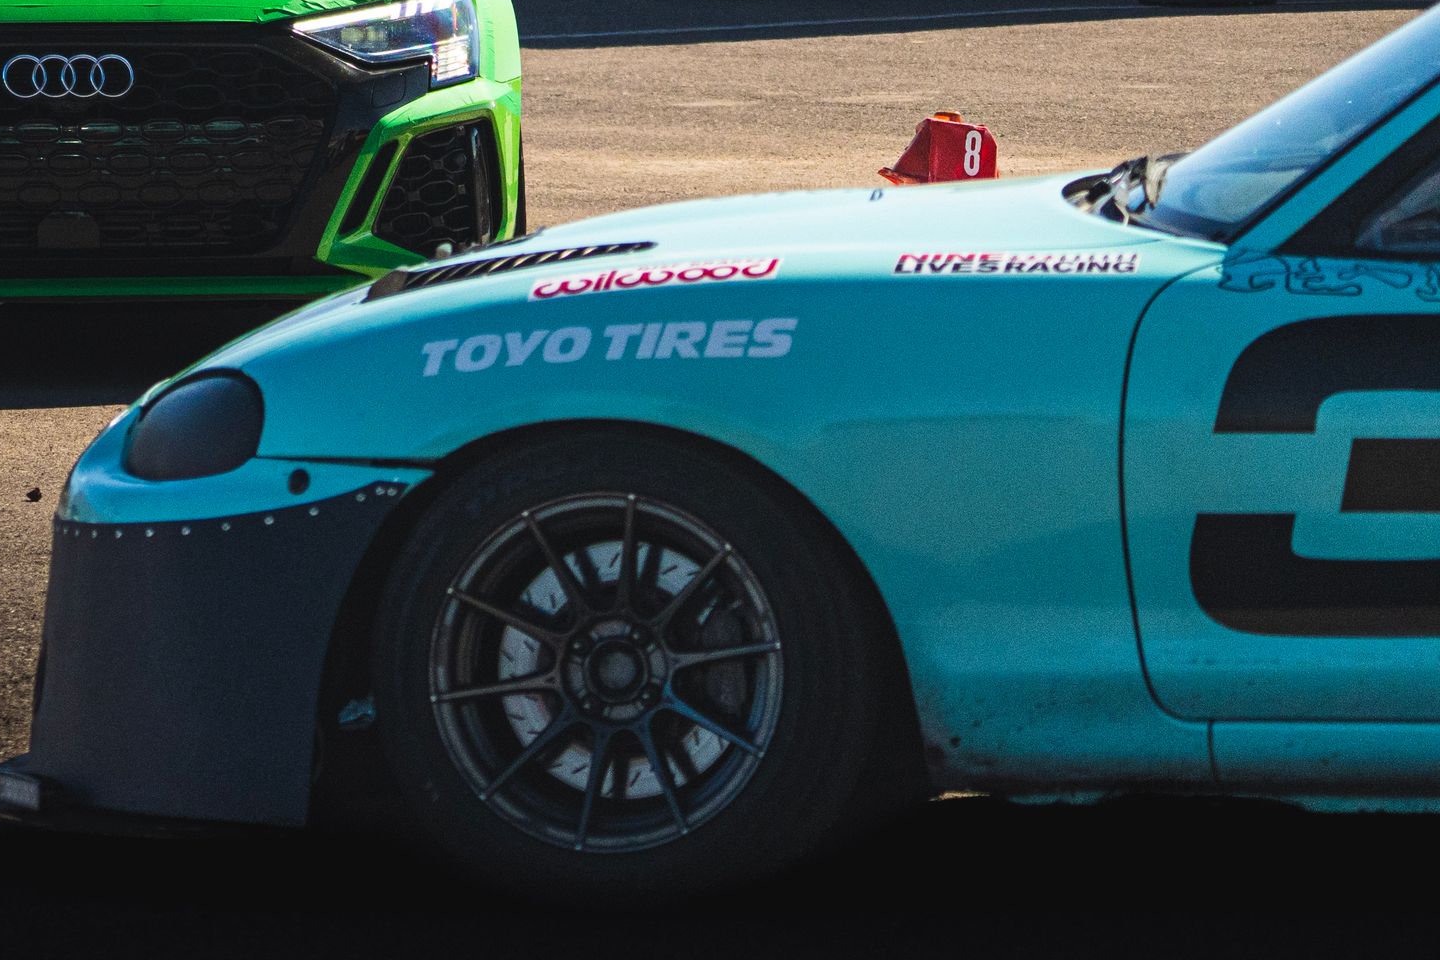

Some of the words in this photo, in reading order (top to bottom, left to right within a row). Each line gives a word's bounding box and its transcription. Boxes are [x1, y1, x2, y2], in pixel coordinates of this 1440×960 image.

[964, 130, 982, 176] 8
[533, 258, 779, 299] wilwood
[1003, 261, 1135, 273] RACING
[421, 326, 592, 378] TOYO
[603, 317, 799, 361] TIRES
